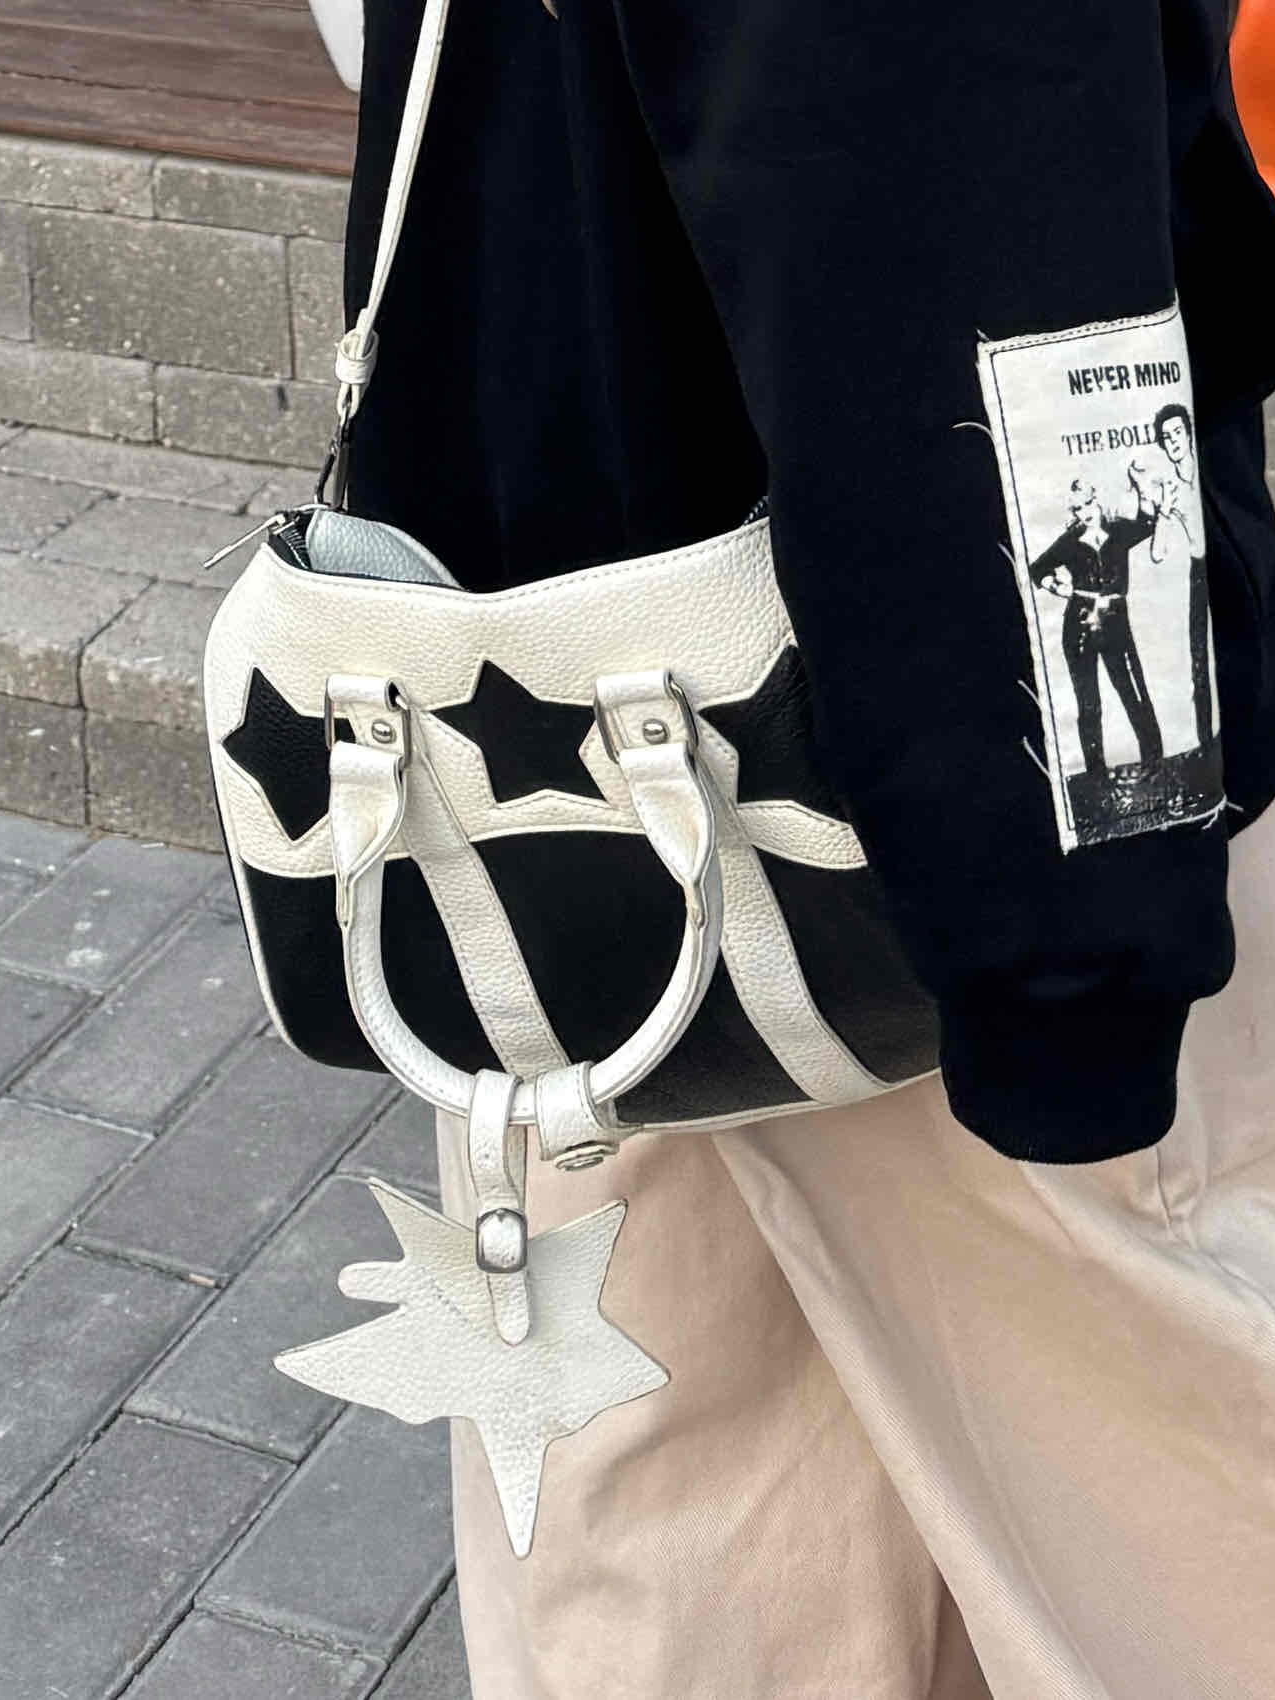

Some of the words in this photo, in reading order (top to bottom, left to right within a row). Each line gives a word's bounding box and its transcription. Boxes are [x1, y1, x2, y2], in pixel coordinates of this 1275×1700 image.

[1067, 364, 1131, 396] NEVER
[1133, 360, 1181, 388] MIND
[1061, 430, 1104, 456] THE
